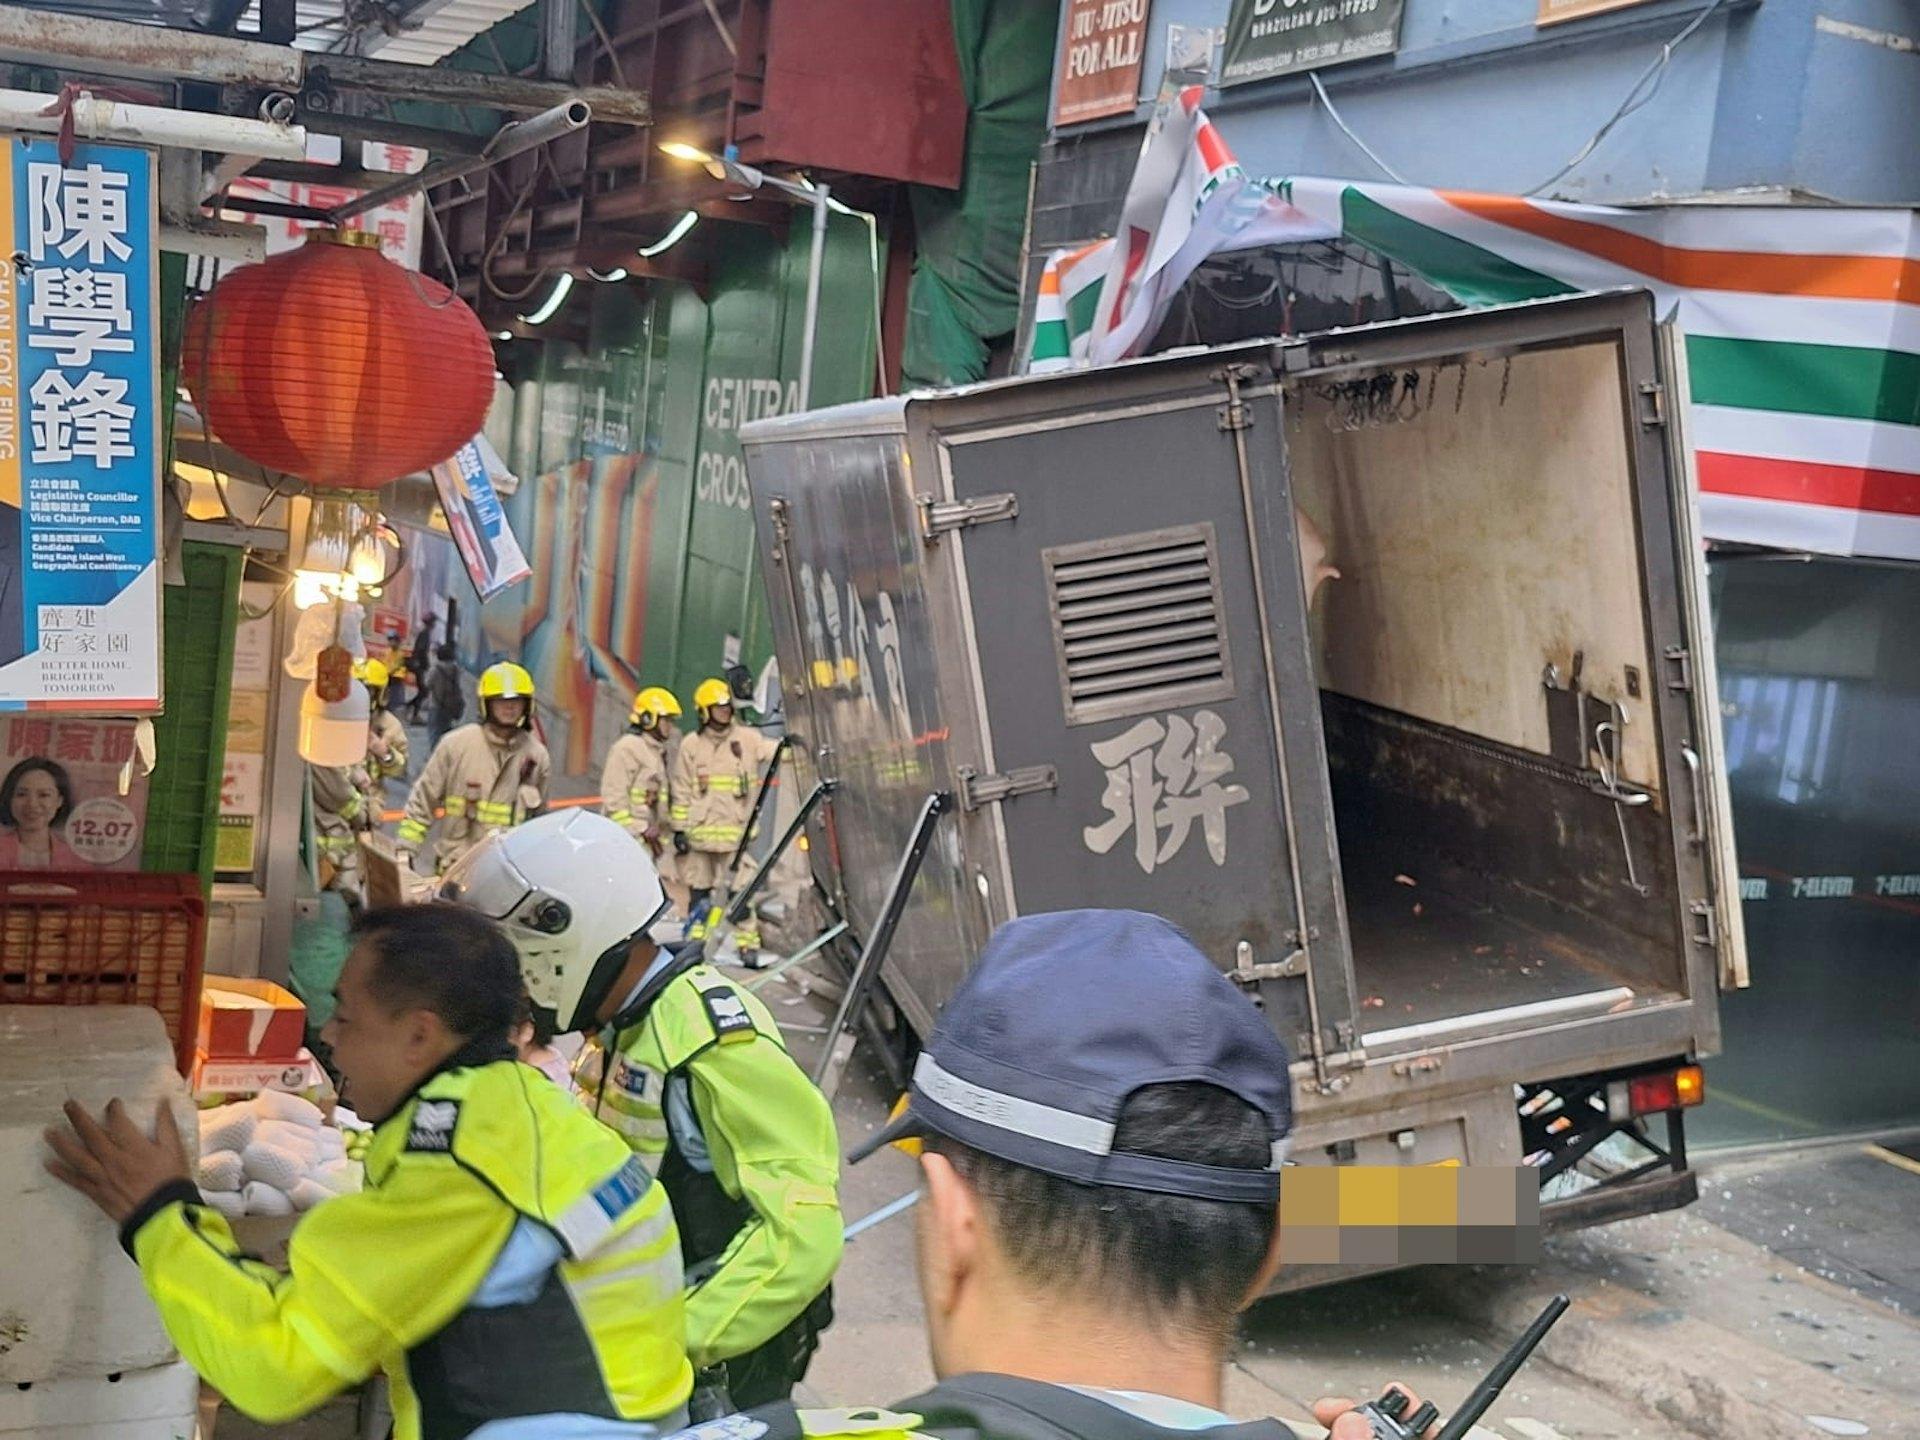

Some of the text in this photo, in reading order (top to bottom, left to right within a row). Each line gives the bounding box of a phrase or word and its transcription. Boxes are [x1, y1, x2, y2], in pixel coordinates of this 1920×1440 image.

[1101, 31, 1141, 70] ALL
[27, 161, 137, 470] 陳學鋒
[705, 378, 804, 429] CENTRA
[697, 452, 752, 511] CROS
[30, 492, 139, 502] Legislative Councillor
[30, 513, 141, 525] Vice Chairperson, DAB
[31, 544, 74, 552] Candidate
[32, 552, 55, 562] Hong
[79, 553, 104, 561] Island
[32, 562, 142, 572] Geographical Constituency
[42, 633, 128, 653] 好家園
[42, 673, 104, 682] BRIGHTER
[43, 684, 115, 693] TOMORROW
[71, 820, 133, 837] 12.07
